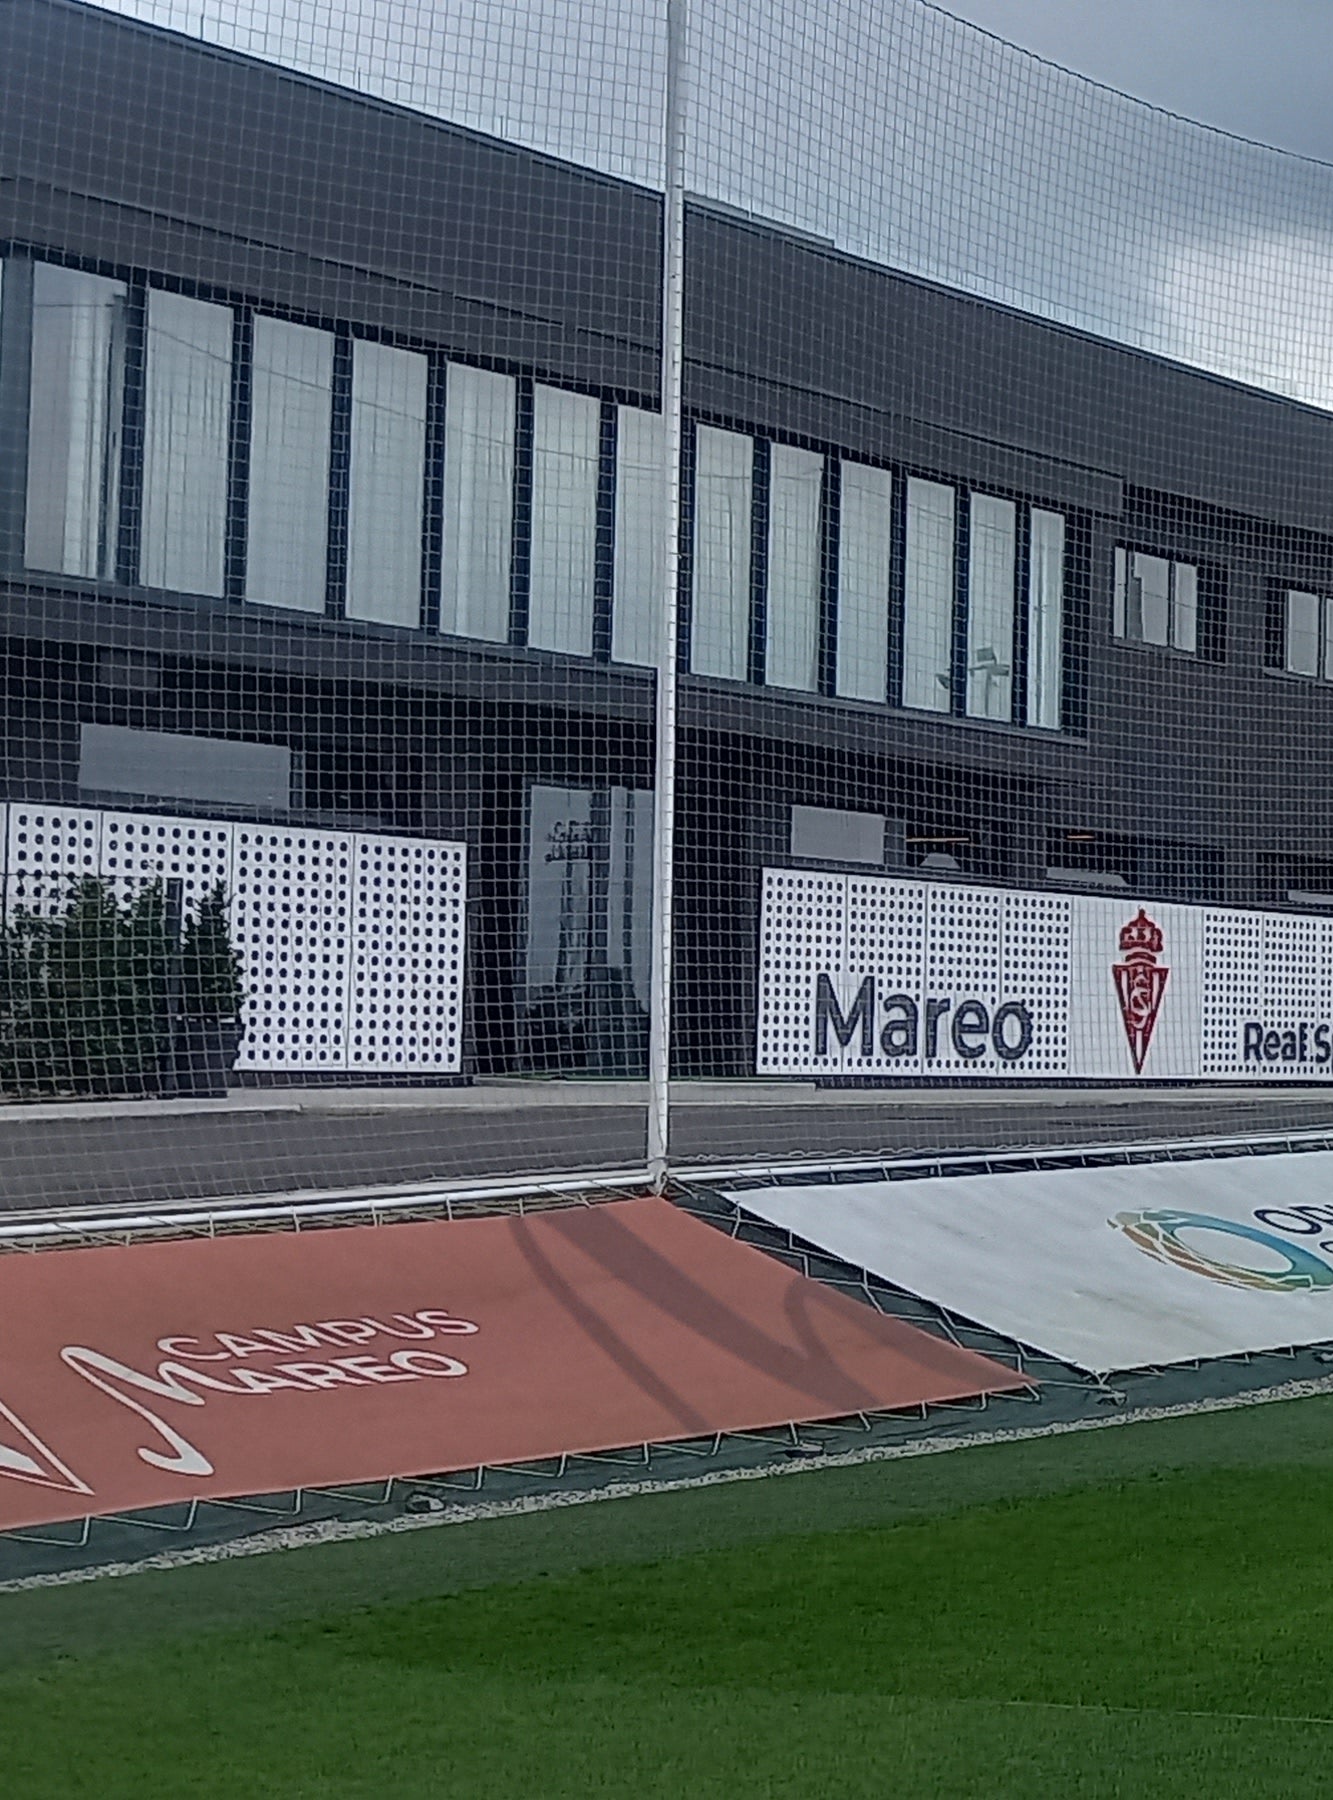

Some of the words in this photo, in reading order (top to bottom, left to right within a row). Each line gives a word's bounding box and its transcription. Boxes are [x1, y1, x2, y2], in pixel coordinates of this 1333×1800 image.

[813, 972, 1034, 1061] Mareo
[1243, 1022, 1308, 1062] Real
[156, 1308, 481, 1361] CAMPUS
[60, 1345, 469, 1477] MAREO
